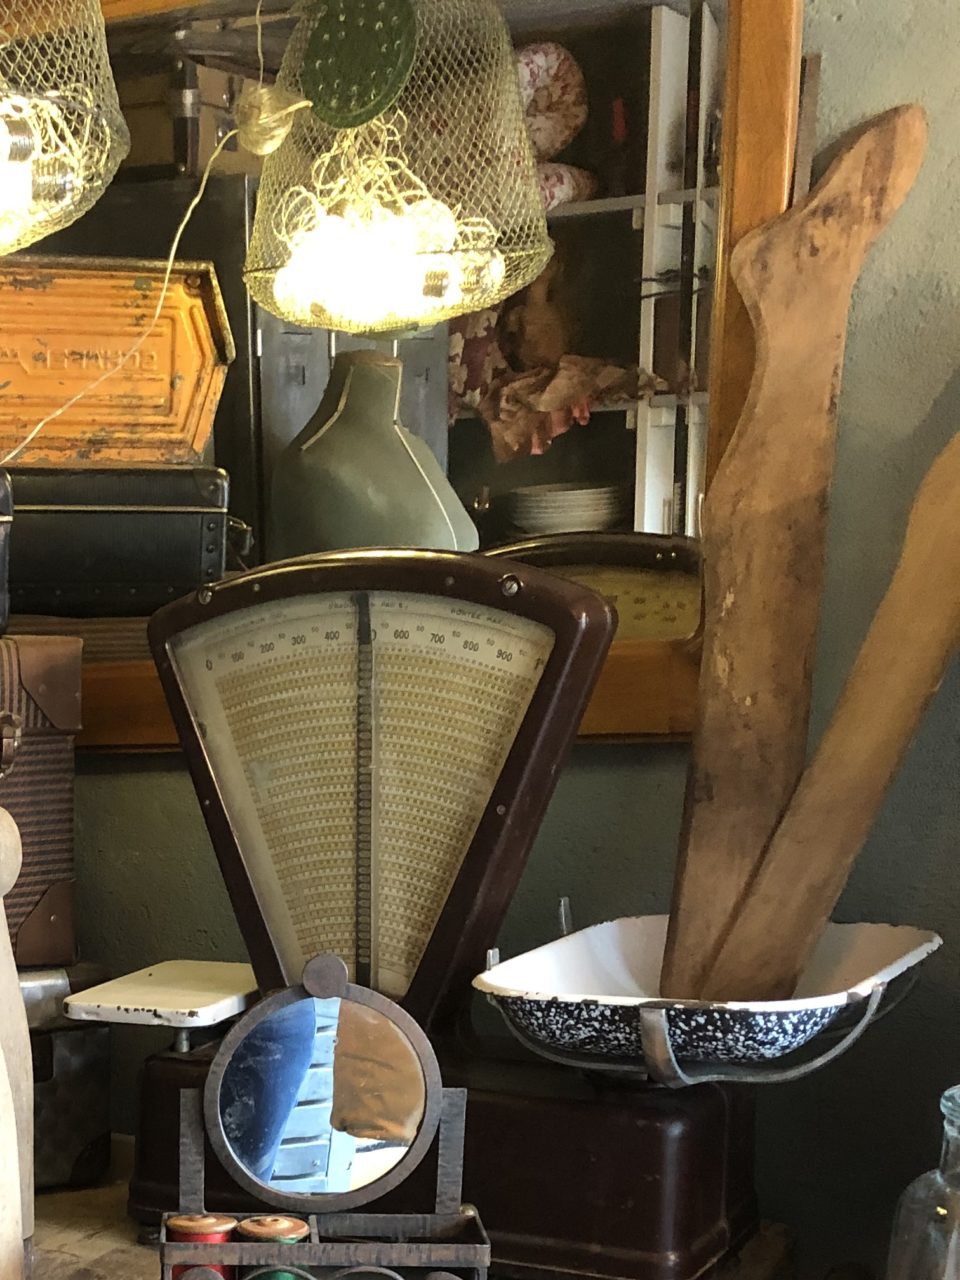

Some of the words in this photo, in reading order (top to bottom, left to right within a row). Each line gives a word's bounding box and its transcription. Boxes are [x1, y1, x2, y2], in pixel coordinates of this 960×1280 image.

[260, 641, 275, 654] 200
[291, 634, 306, 646] 300
[324, 630, 340, 641] 400
[393, 628, 410, 640] 600
[429, 631, 446, 644] 700
[462, 638, 480, 653] 800
[495, 648, 514, 663] 900
